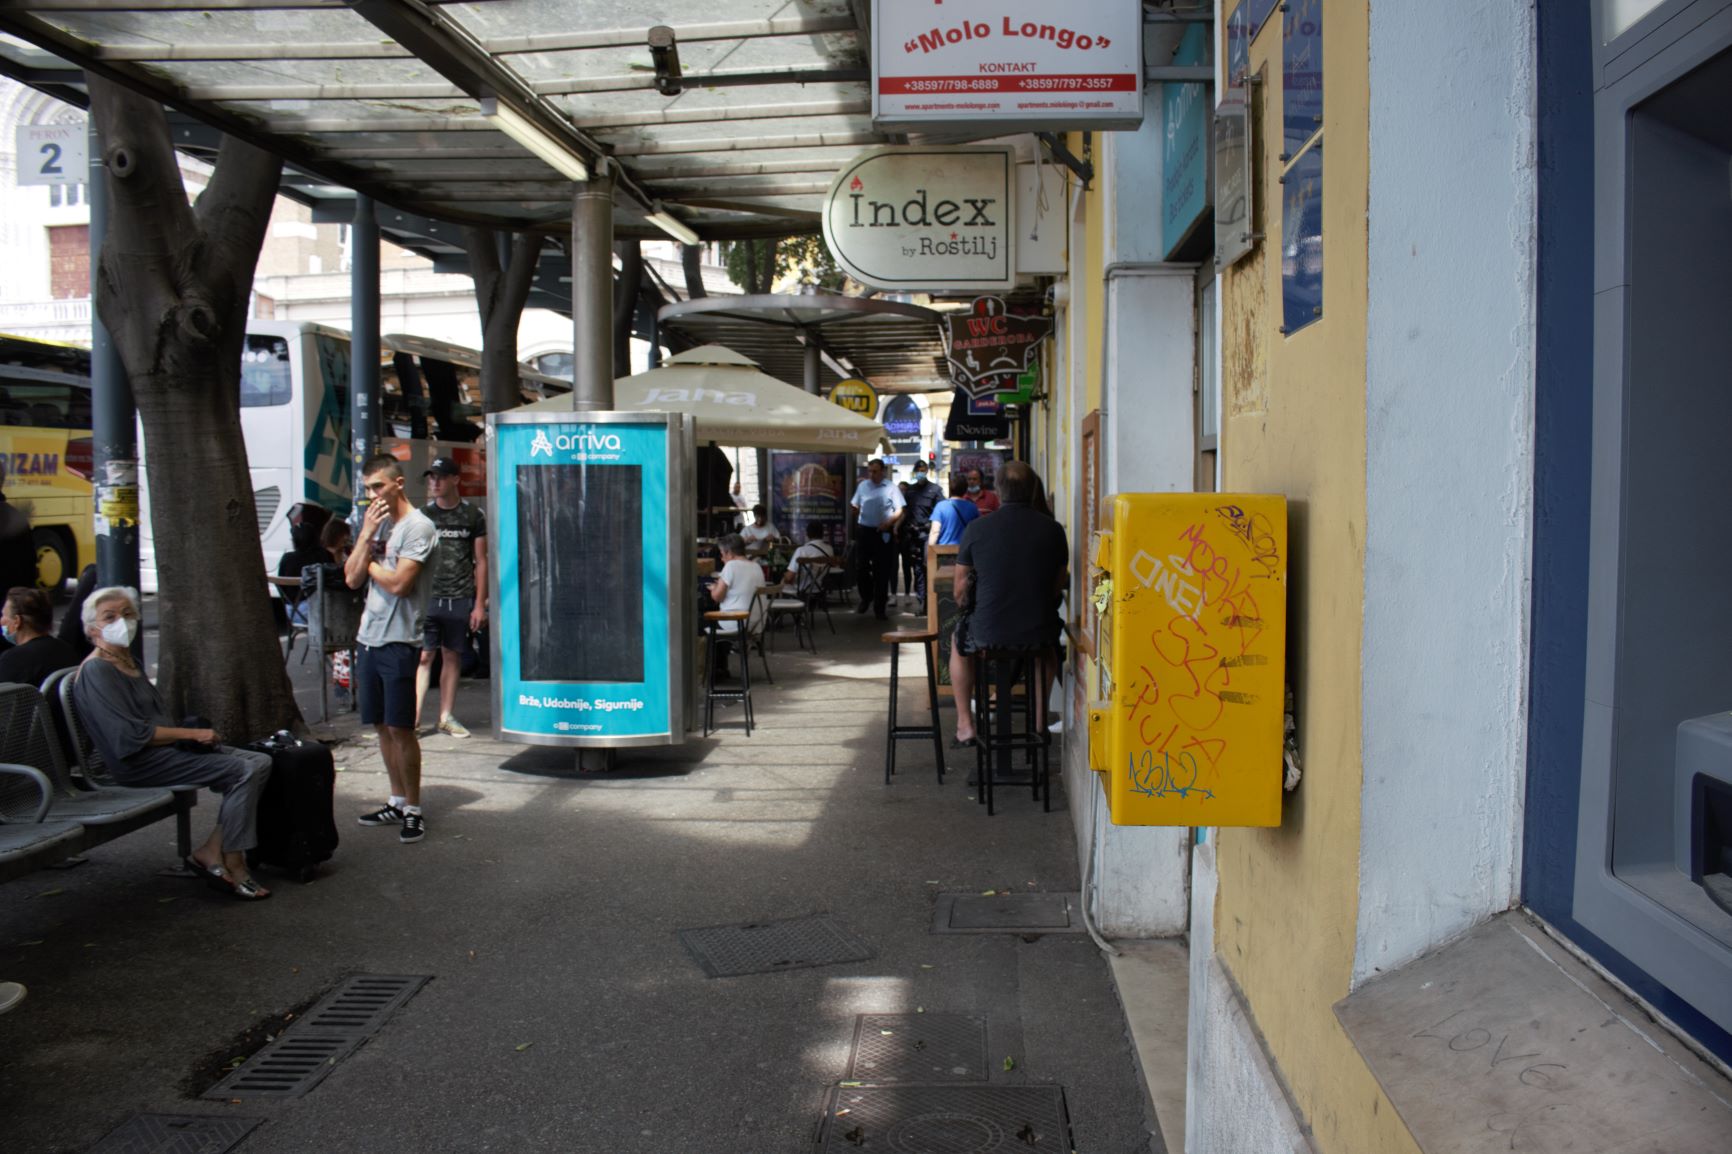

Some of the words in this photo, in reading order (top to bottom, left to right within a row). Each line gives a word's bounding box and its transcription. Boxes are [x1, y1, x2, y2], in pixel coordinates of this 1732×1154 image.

[978, 62, 1038, 73] KONTAKT
[903, 79, 999, 91] +38597/798-6889
[1018, 78, 1113, 90] +38597/797-3557
[39, 142, 63, 174] 2
[849, 188, 997, 228] Index
[901, 245, 917, 258] by
[966, 314, 1008, 338] WC
[956, 423, 998, 436] iNovine
[555, 430, 621, 450] arriva
[519, 694, 542, 708] Brže,
[542, 696, 593, 711] Udobnije,
[594, 698, 644, 712] Sigurnije
